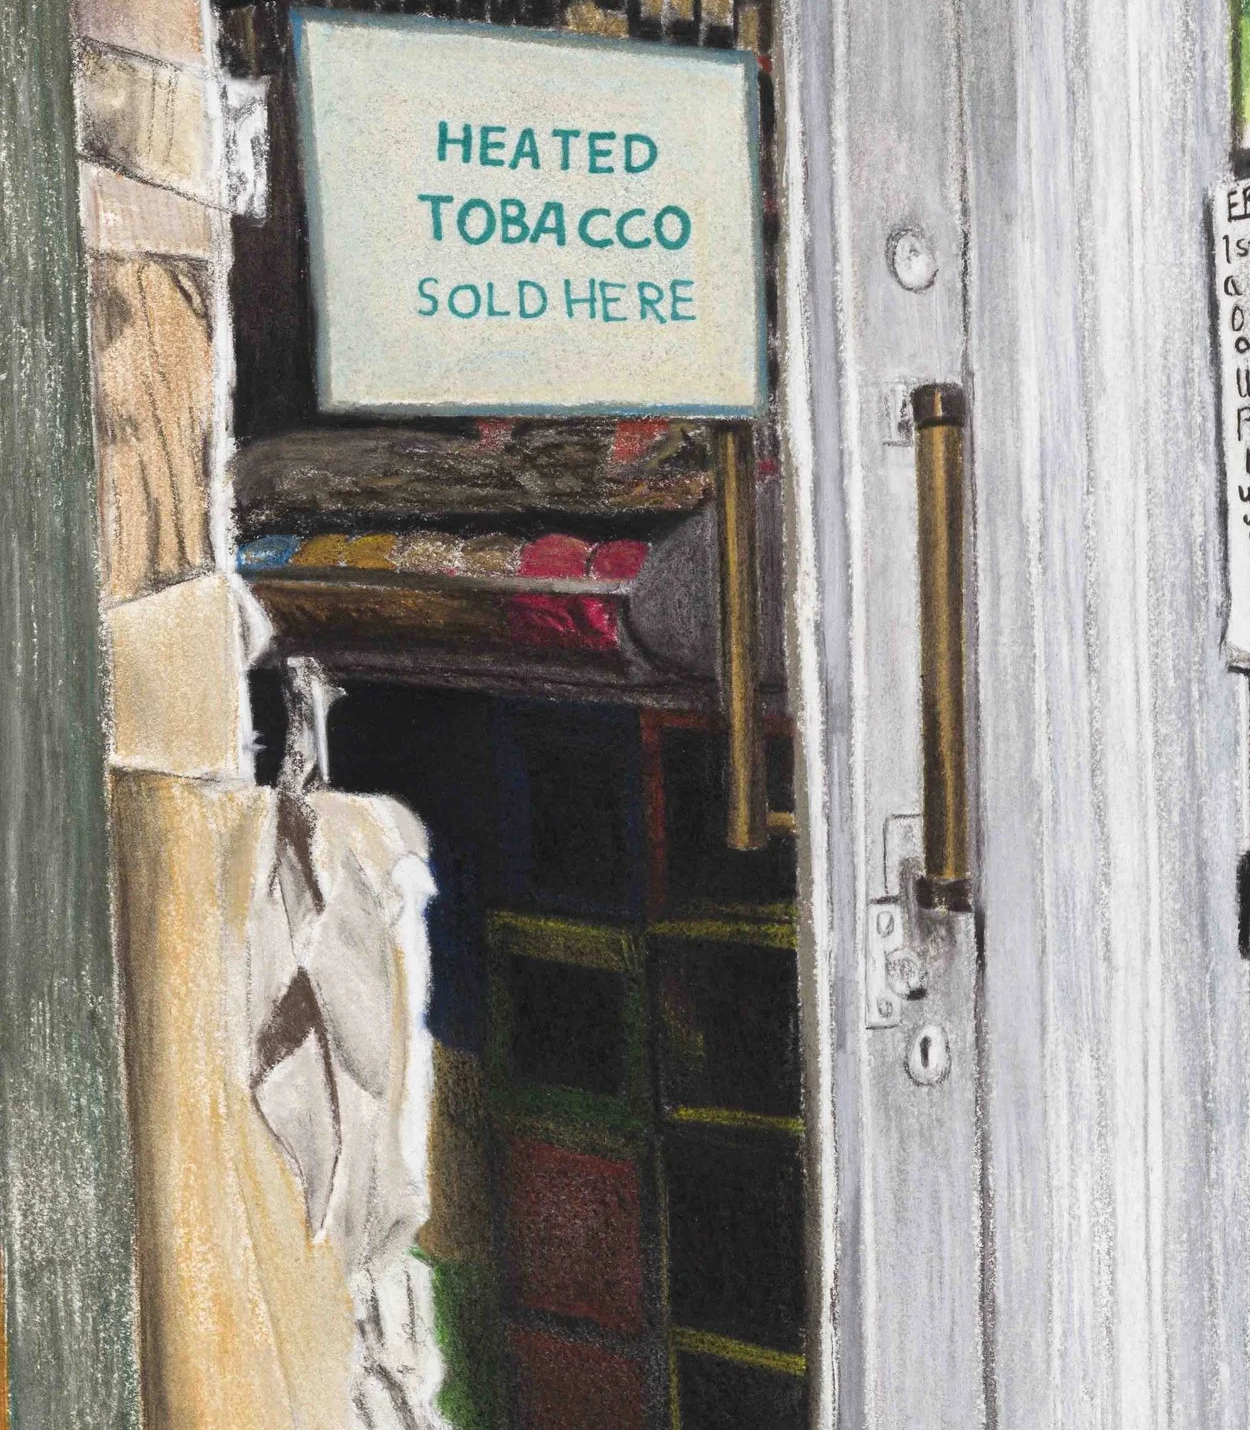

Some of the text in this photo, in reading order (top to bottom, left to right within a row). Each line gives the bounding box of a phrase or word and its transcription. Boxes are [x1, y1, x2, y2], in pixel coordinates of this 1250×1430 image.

[437, 120, 659, 174] HEATED
[417, 193, 692, 250] TOBACCO
[418, 277, 696, 324] SOLD HERE
[1224, 275, 1243, 296] a
